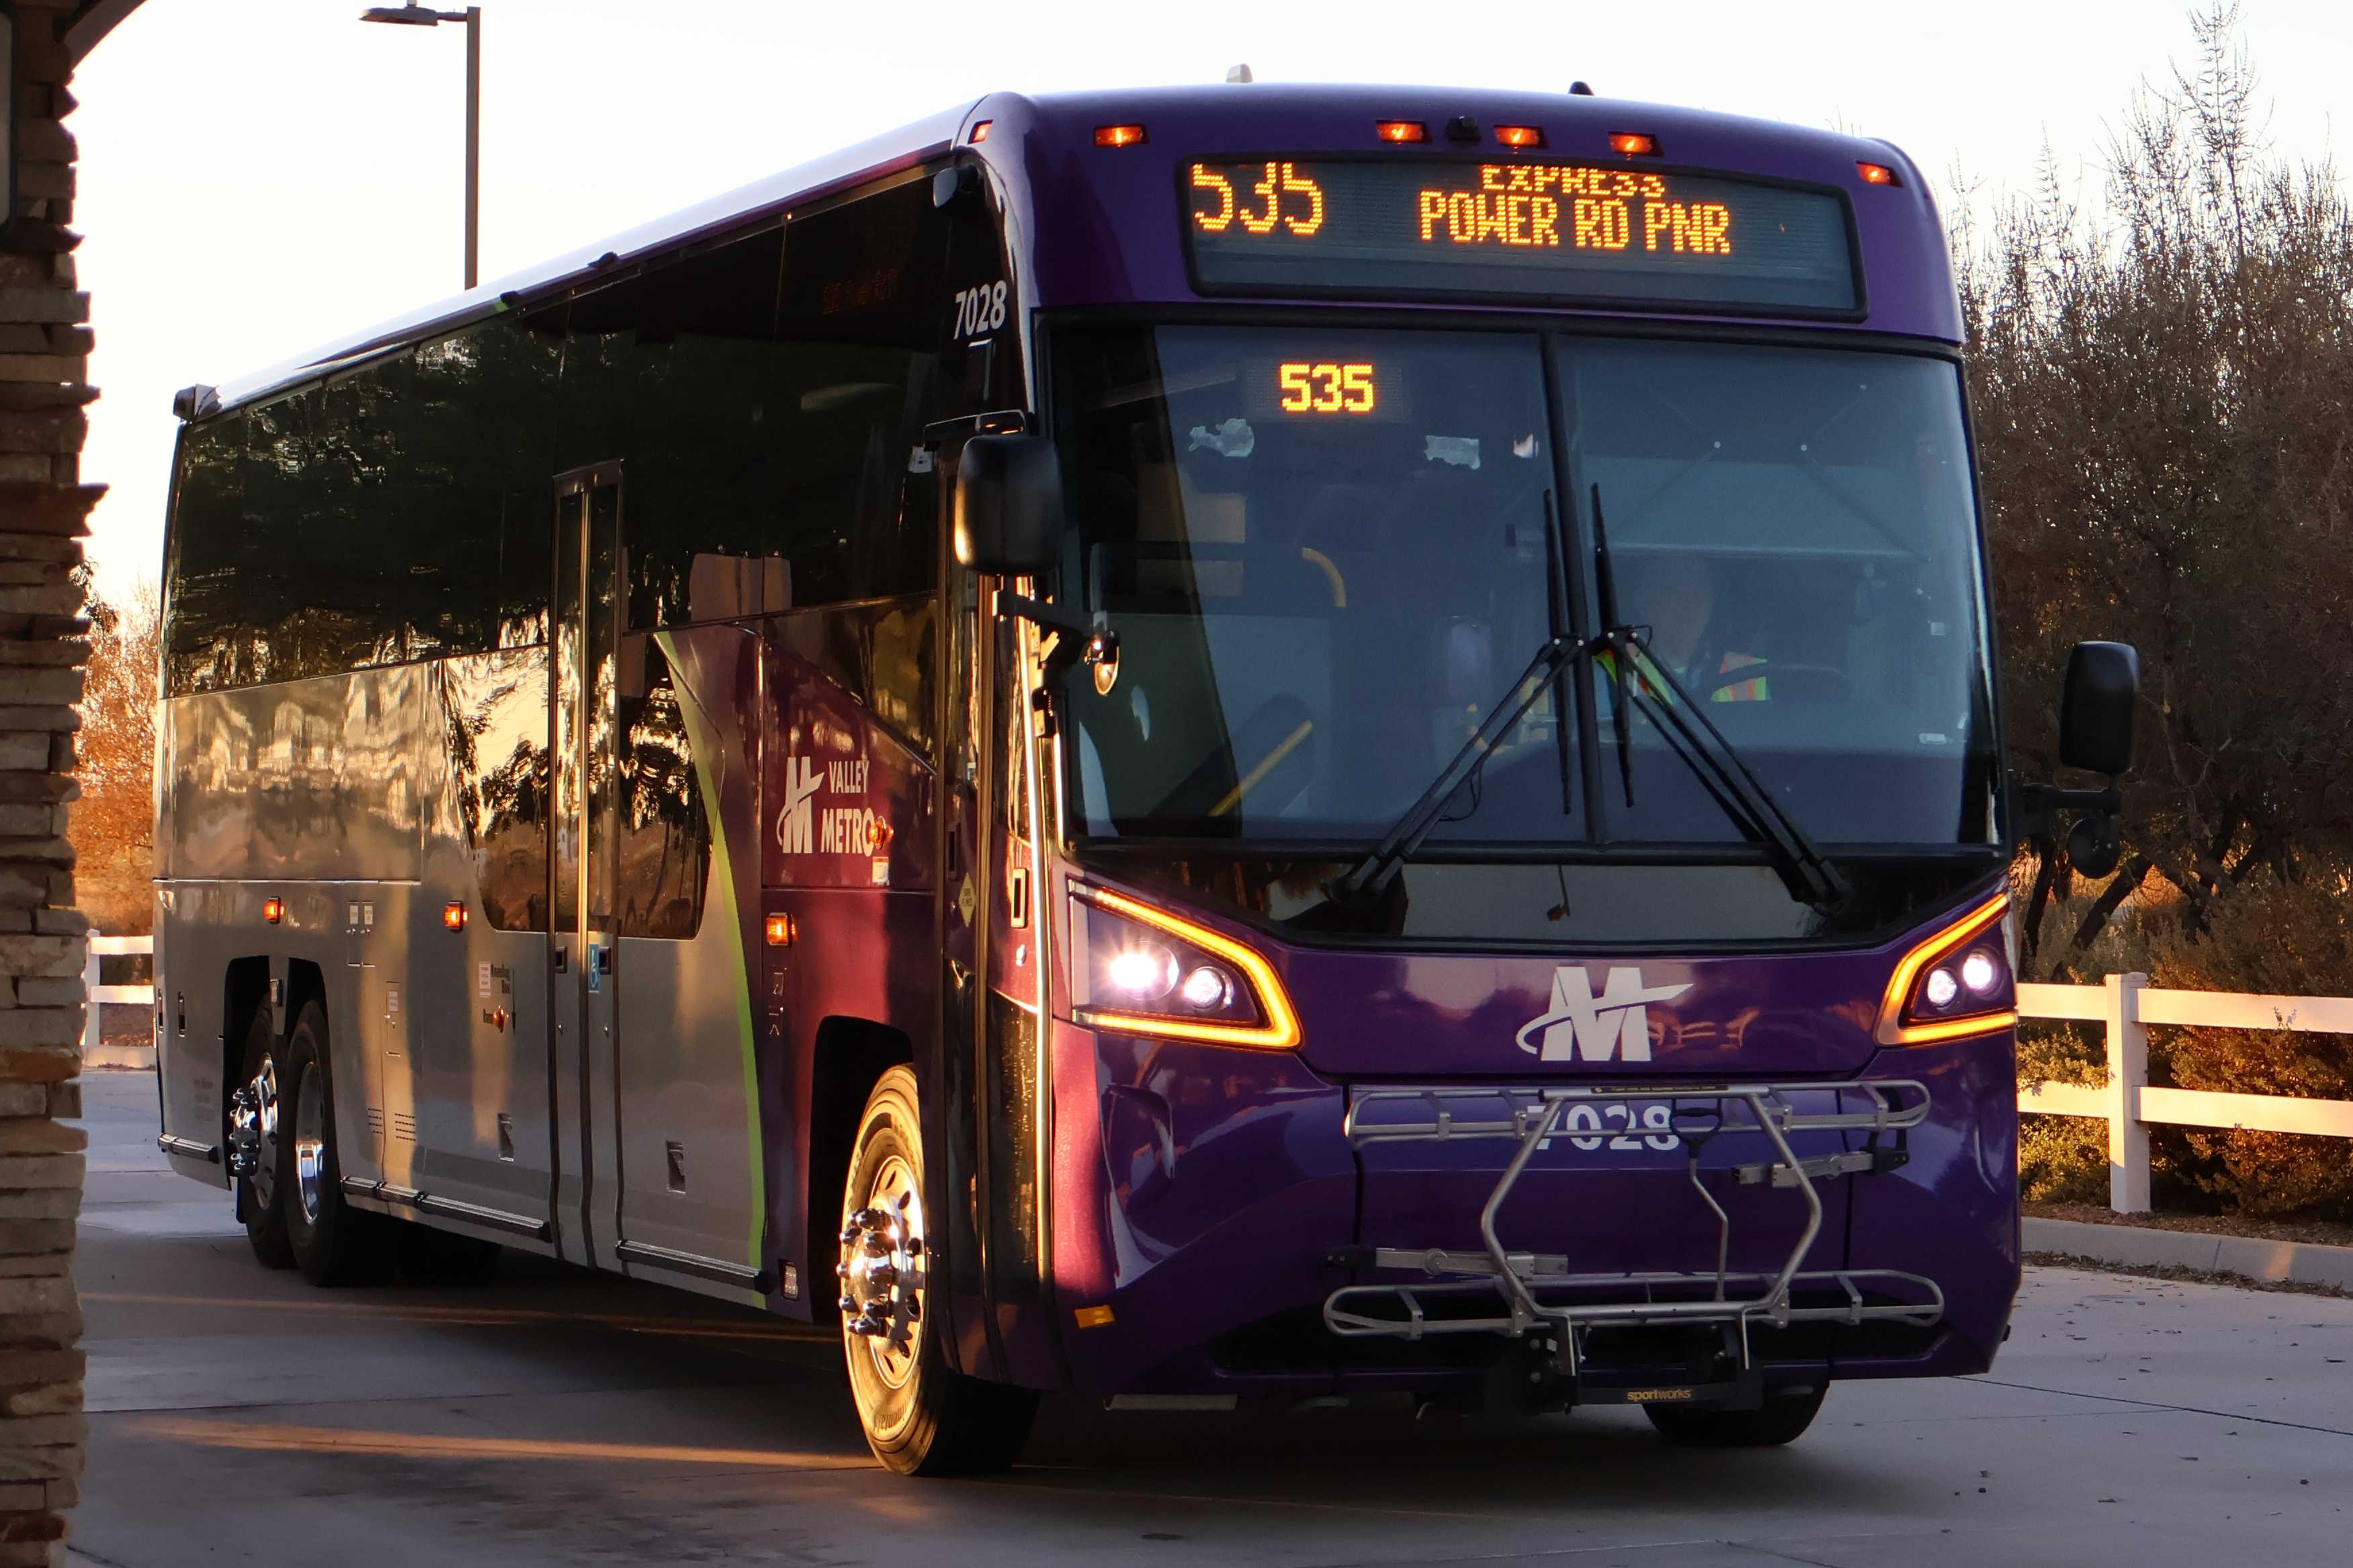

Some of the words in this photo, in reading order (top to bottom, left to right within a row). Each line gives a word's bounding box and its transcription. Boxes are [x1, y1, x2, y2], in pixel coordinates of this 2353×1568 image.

[1193, 162, 1322, 233] 535
[1481, 165, 1665, 198] EXPRESS
[1420, 191, 1559, 245] POWER
[1575, 200, 1629, 248] RD
[1644, 202, 1730, 253] PNR
[953, 280, 1007, 340] 7028
[1280, 363, 1373, 412] 535
[828, 760, 869, 793] VALLEY
[820, 808, 875, 857] METRO
[1627, 1389, 1693, 1402] sportworks
